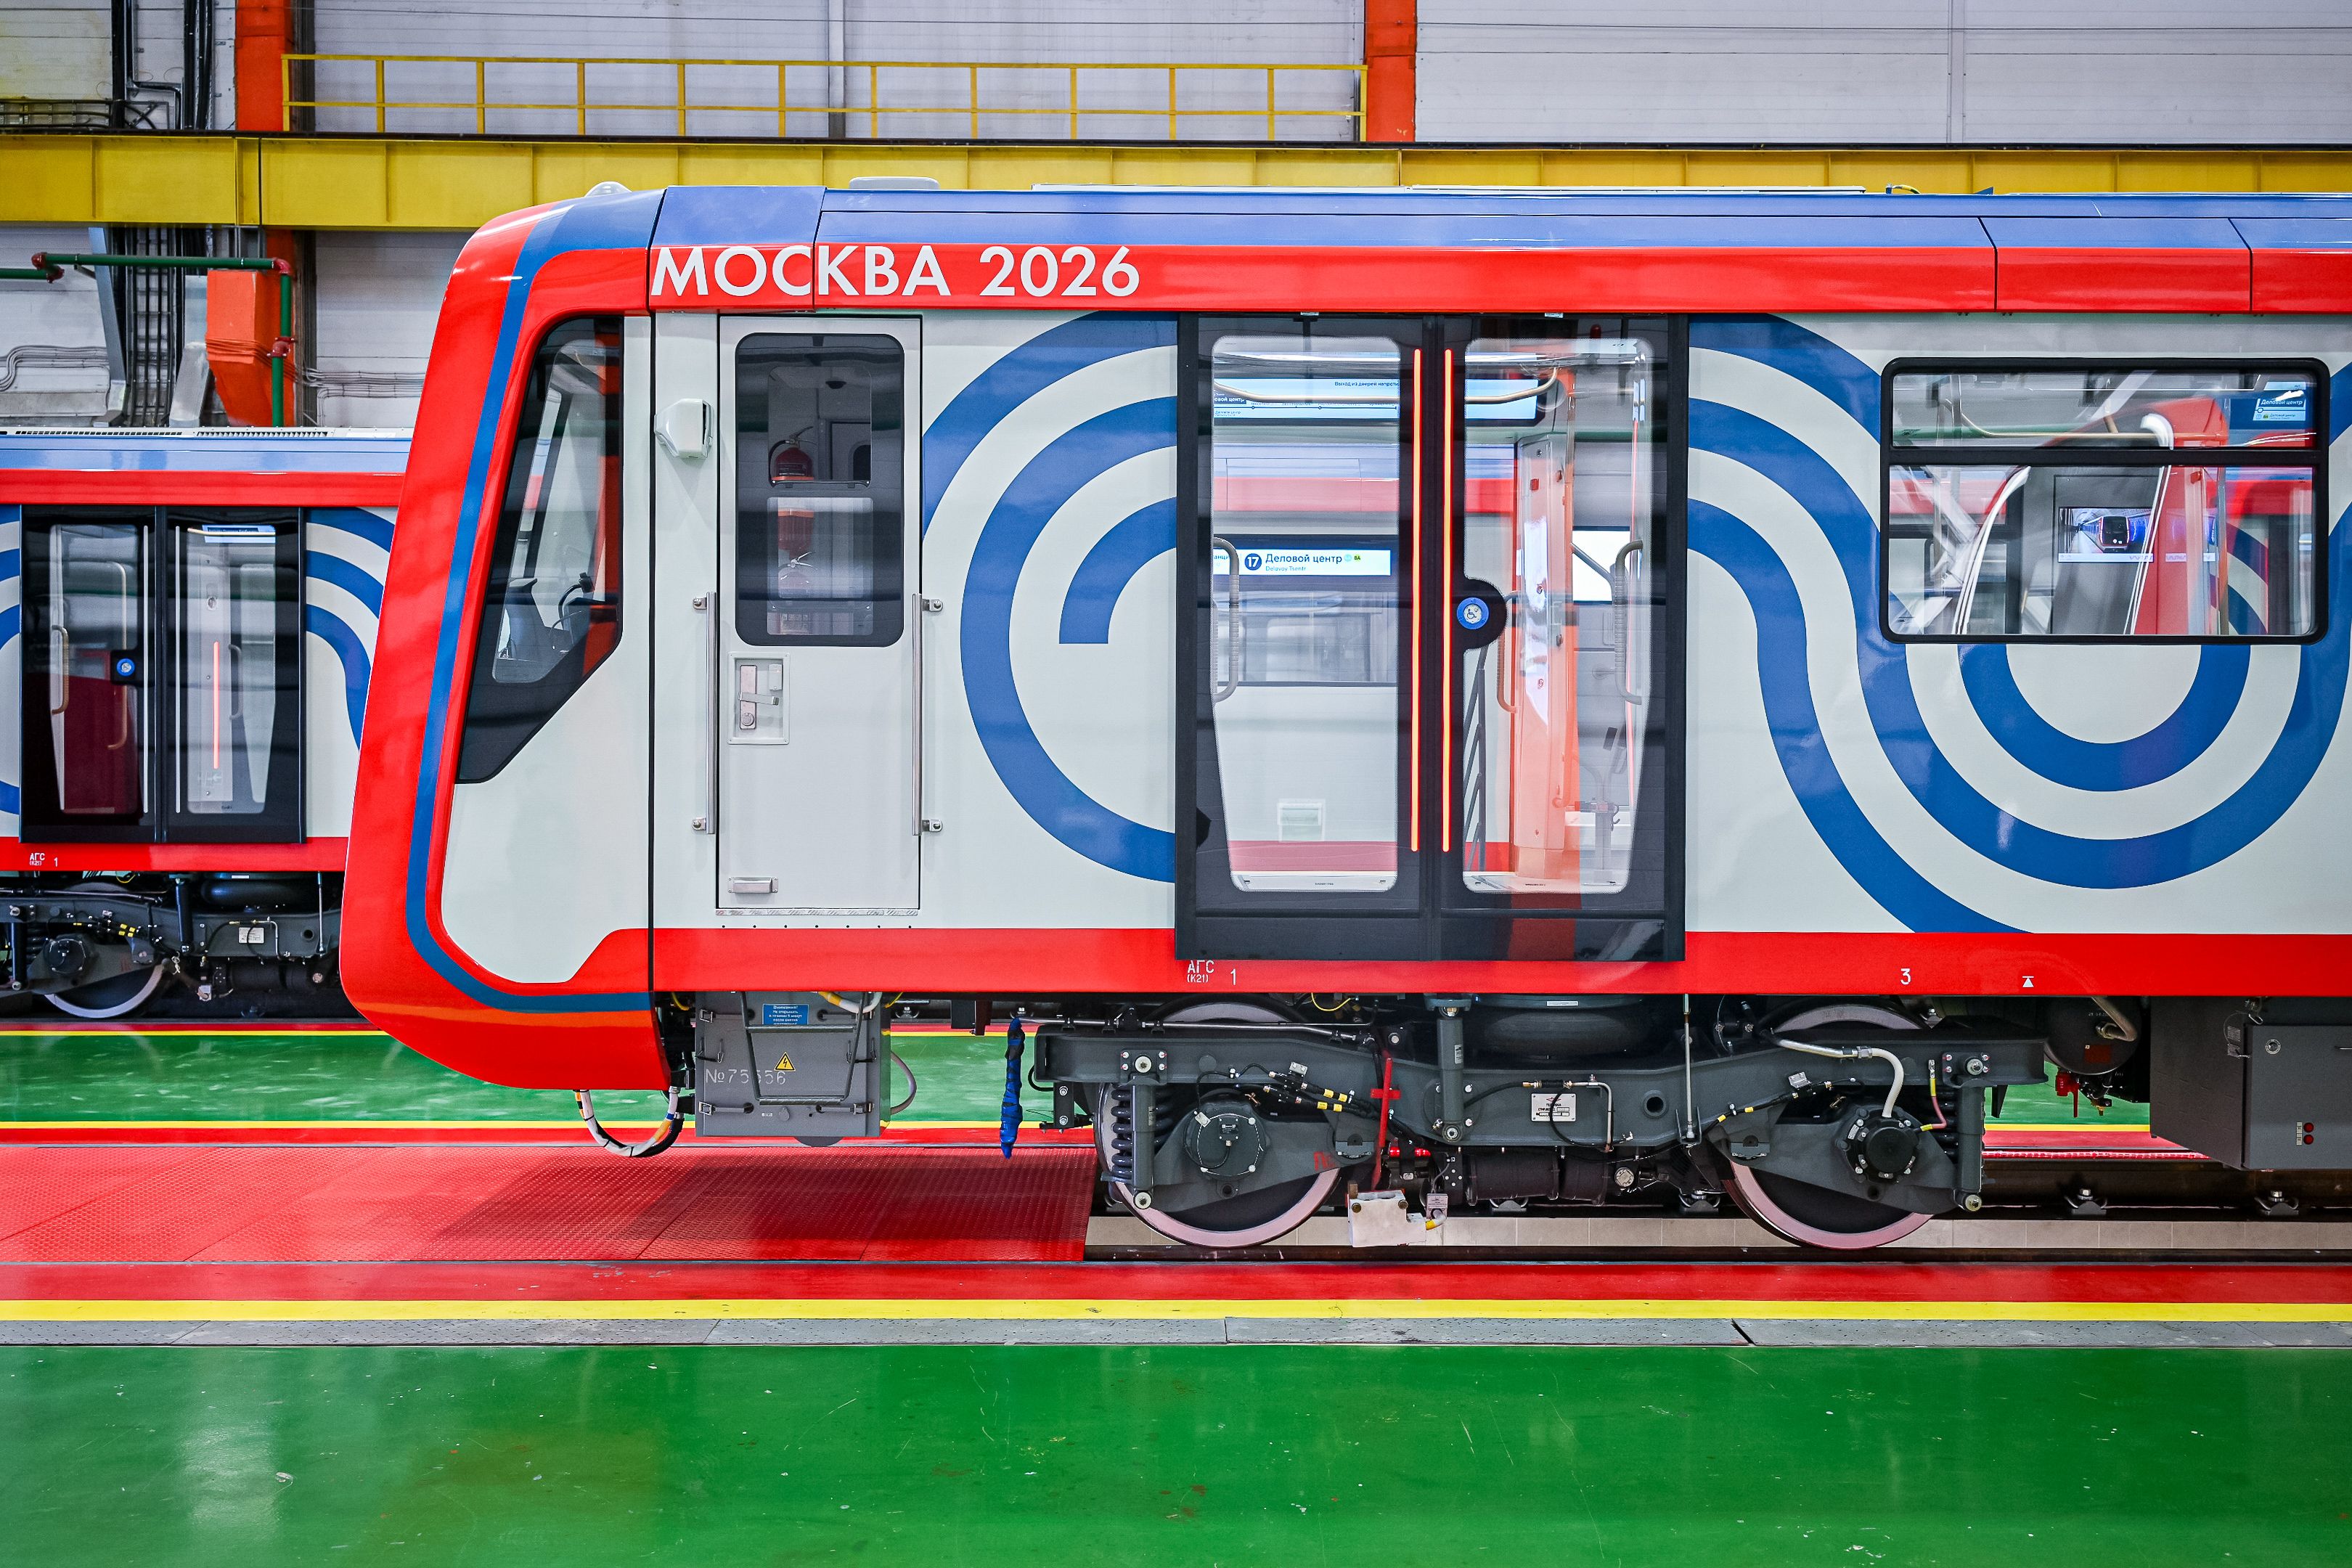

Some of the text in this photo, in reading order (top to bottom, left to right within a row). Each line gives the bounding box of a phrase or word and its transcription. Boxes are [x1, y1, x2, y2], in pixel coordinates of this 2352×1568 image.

[650, 245, 1140, 298] МОСКВА 2026
[1247, 556, 1259, 568] 17
[1265, 553, 1310, 563] Деловой
[1312, 555, 1342, 564] центр
[54, 857, 58, 867] 1
[1187, 960, 1214, 973] АГС
[1187, 974, 1209, 983] (К21)
[1230, 968, 1236, 985] 1
[1900, 968, 1911, 985] 3
